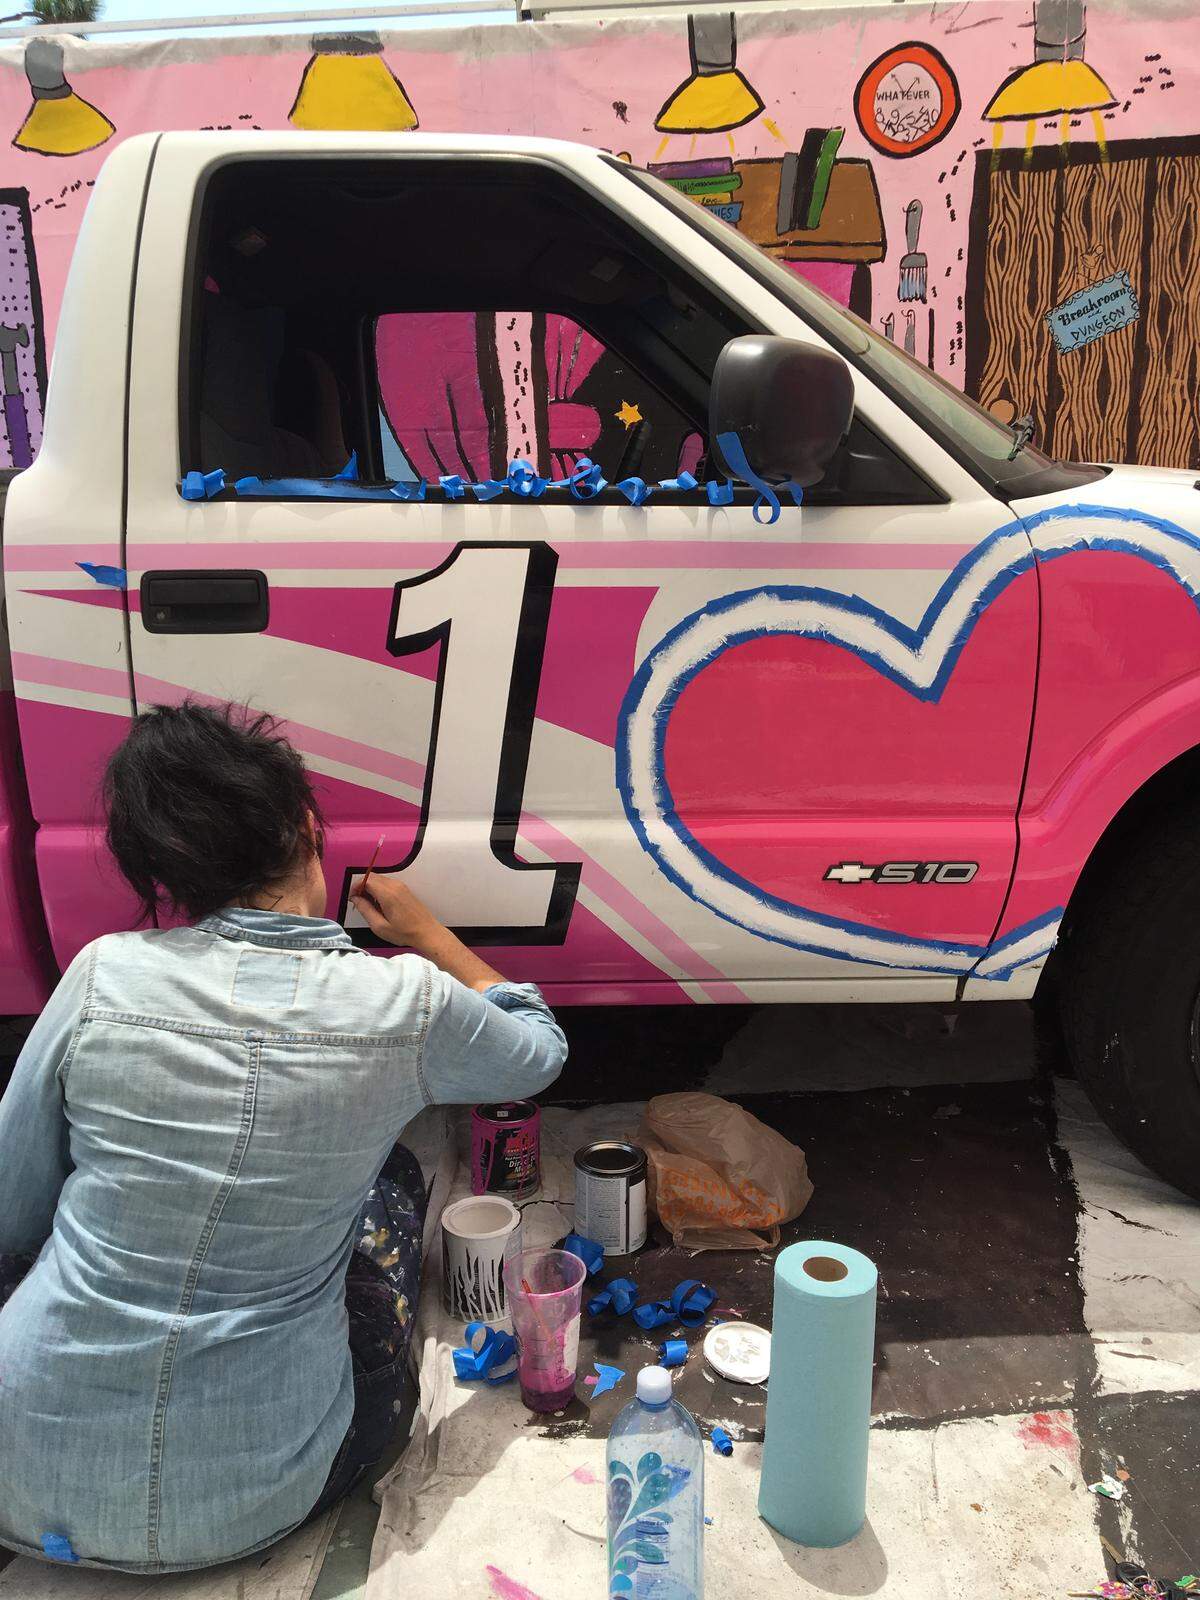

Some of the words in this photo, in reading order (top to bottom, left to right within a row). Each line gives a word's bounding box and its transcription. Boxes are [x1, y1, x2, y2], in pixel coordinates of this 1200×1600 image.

[876, 90, 931, 101] WHATEVER
[1057, 287, 1127, 326] Breakroom
[337, 541, 584, 947] 1
[876, 862, 980, 884] S10
